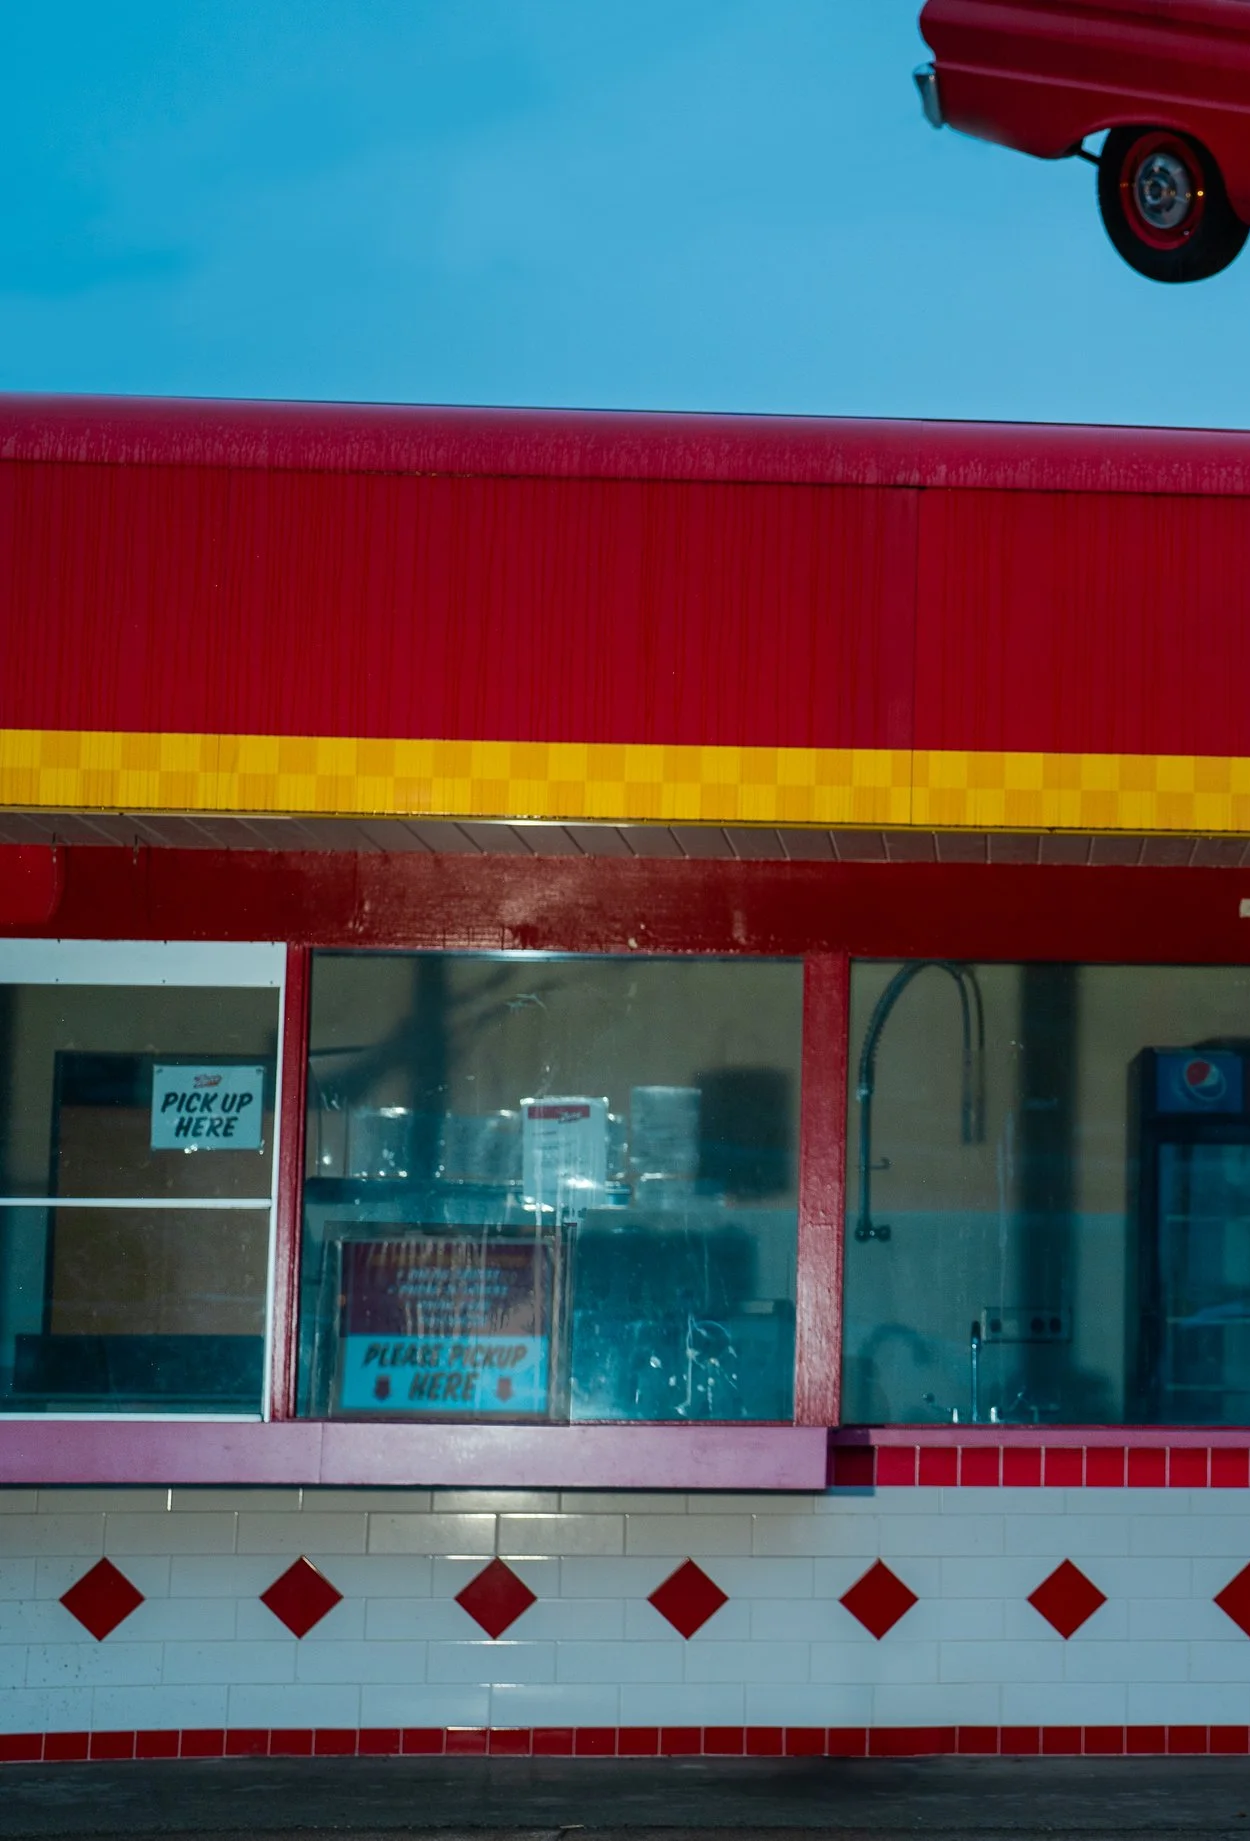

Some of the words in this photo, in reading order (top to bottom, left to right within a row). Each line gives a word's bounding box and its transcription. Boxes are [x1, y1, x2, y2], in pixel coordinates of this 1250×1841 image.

[161, 1092, 218, 1114] PICK
[221, 1092, 253, 1114] UP
[175, 1116, 238, 1138] HERE
[361, 1342, 445, 1369] PLEASE
[408, 1372, 480, 1402] HERE
